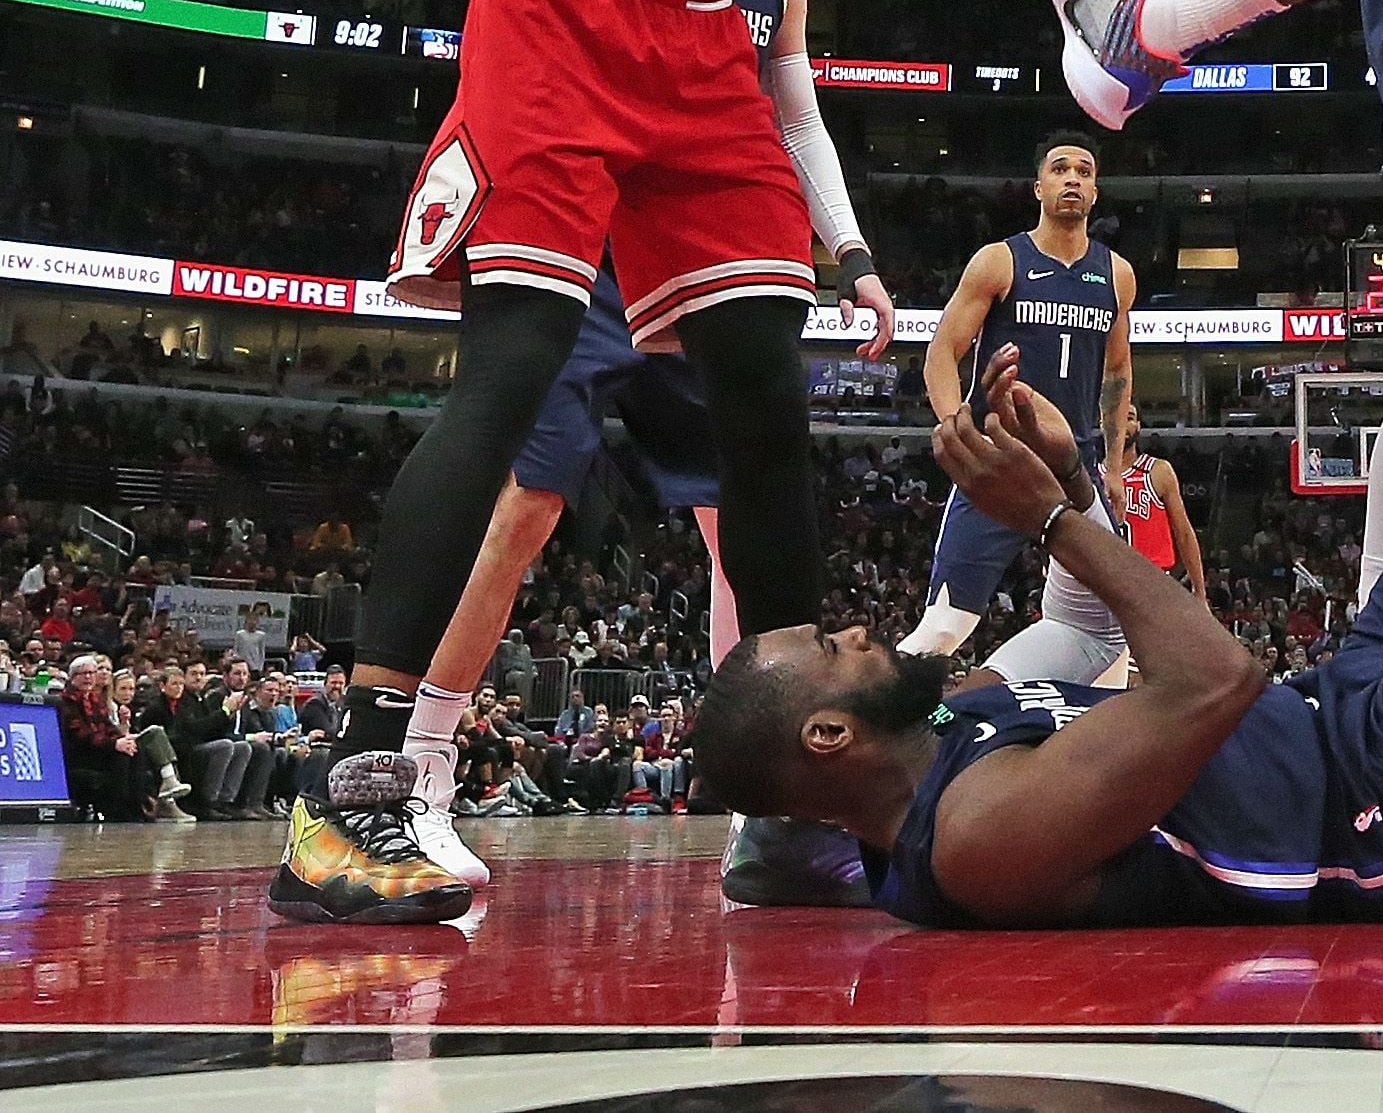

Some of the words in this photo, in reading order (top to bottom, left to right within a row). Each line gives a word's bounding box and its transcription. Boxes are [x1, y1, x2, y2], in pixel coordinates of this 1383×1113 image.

[334, 20, 383, 49] 9:02
[830, 65, 905, 84] CHAMPIONS
[907, 68, 939, 85] CLUB
[1193, 67, 1248, 88] DALLAS
[1290, 67, 1311, 87] 92
[43, 258, 161, 284] SCHAUMBURG
[178, 267, 348, 307] WILDFIRE
[1015, 300, 1113, 333] MAVERICKS
[1167, 321, 1272, 335] SCHAUMBURG
[1059, 333, 1072, 379] 1
